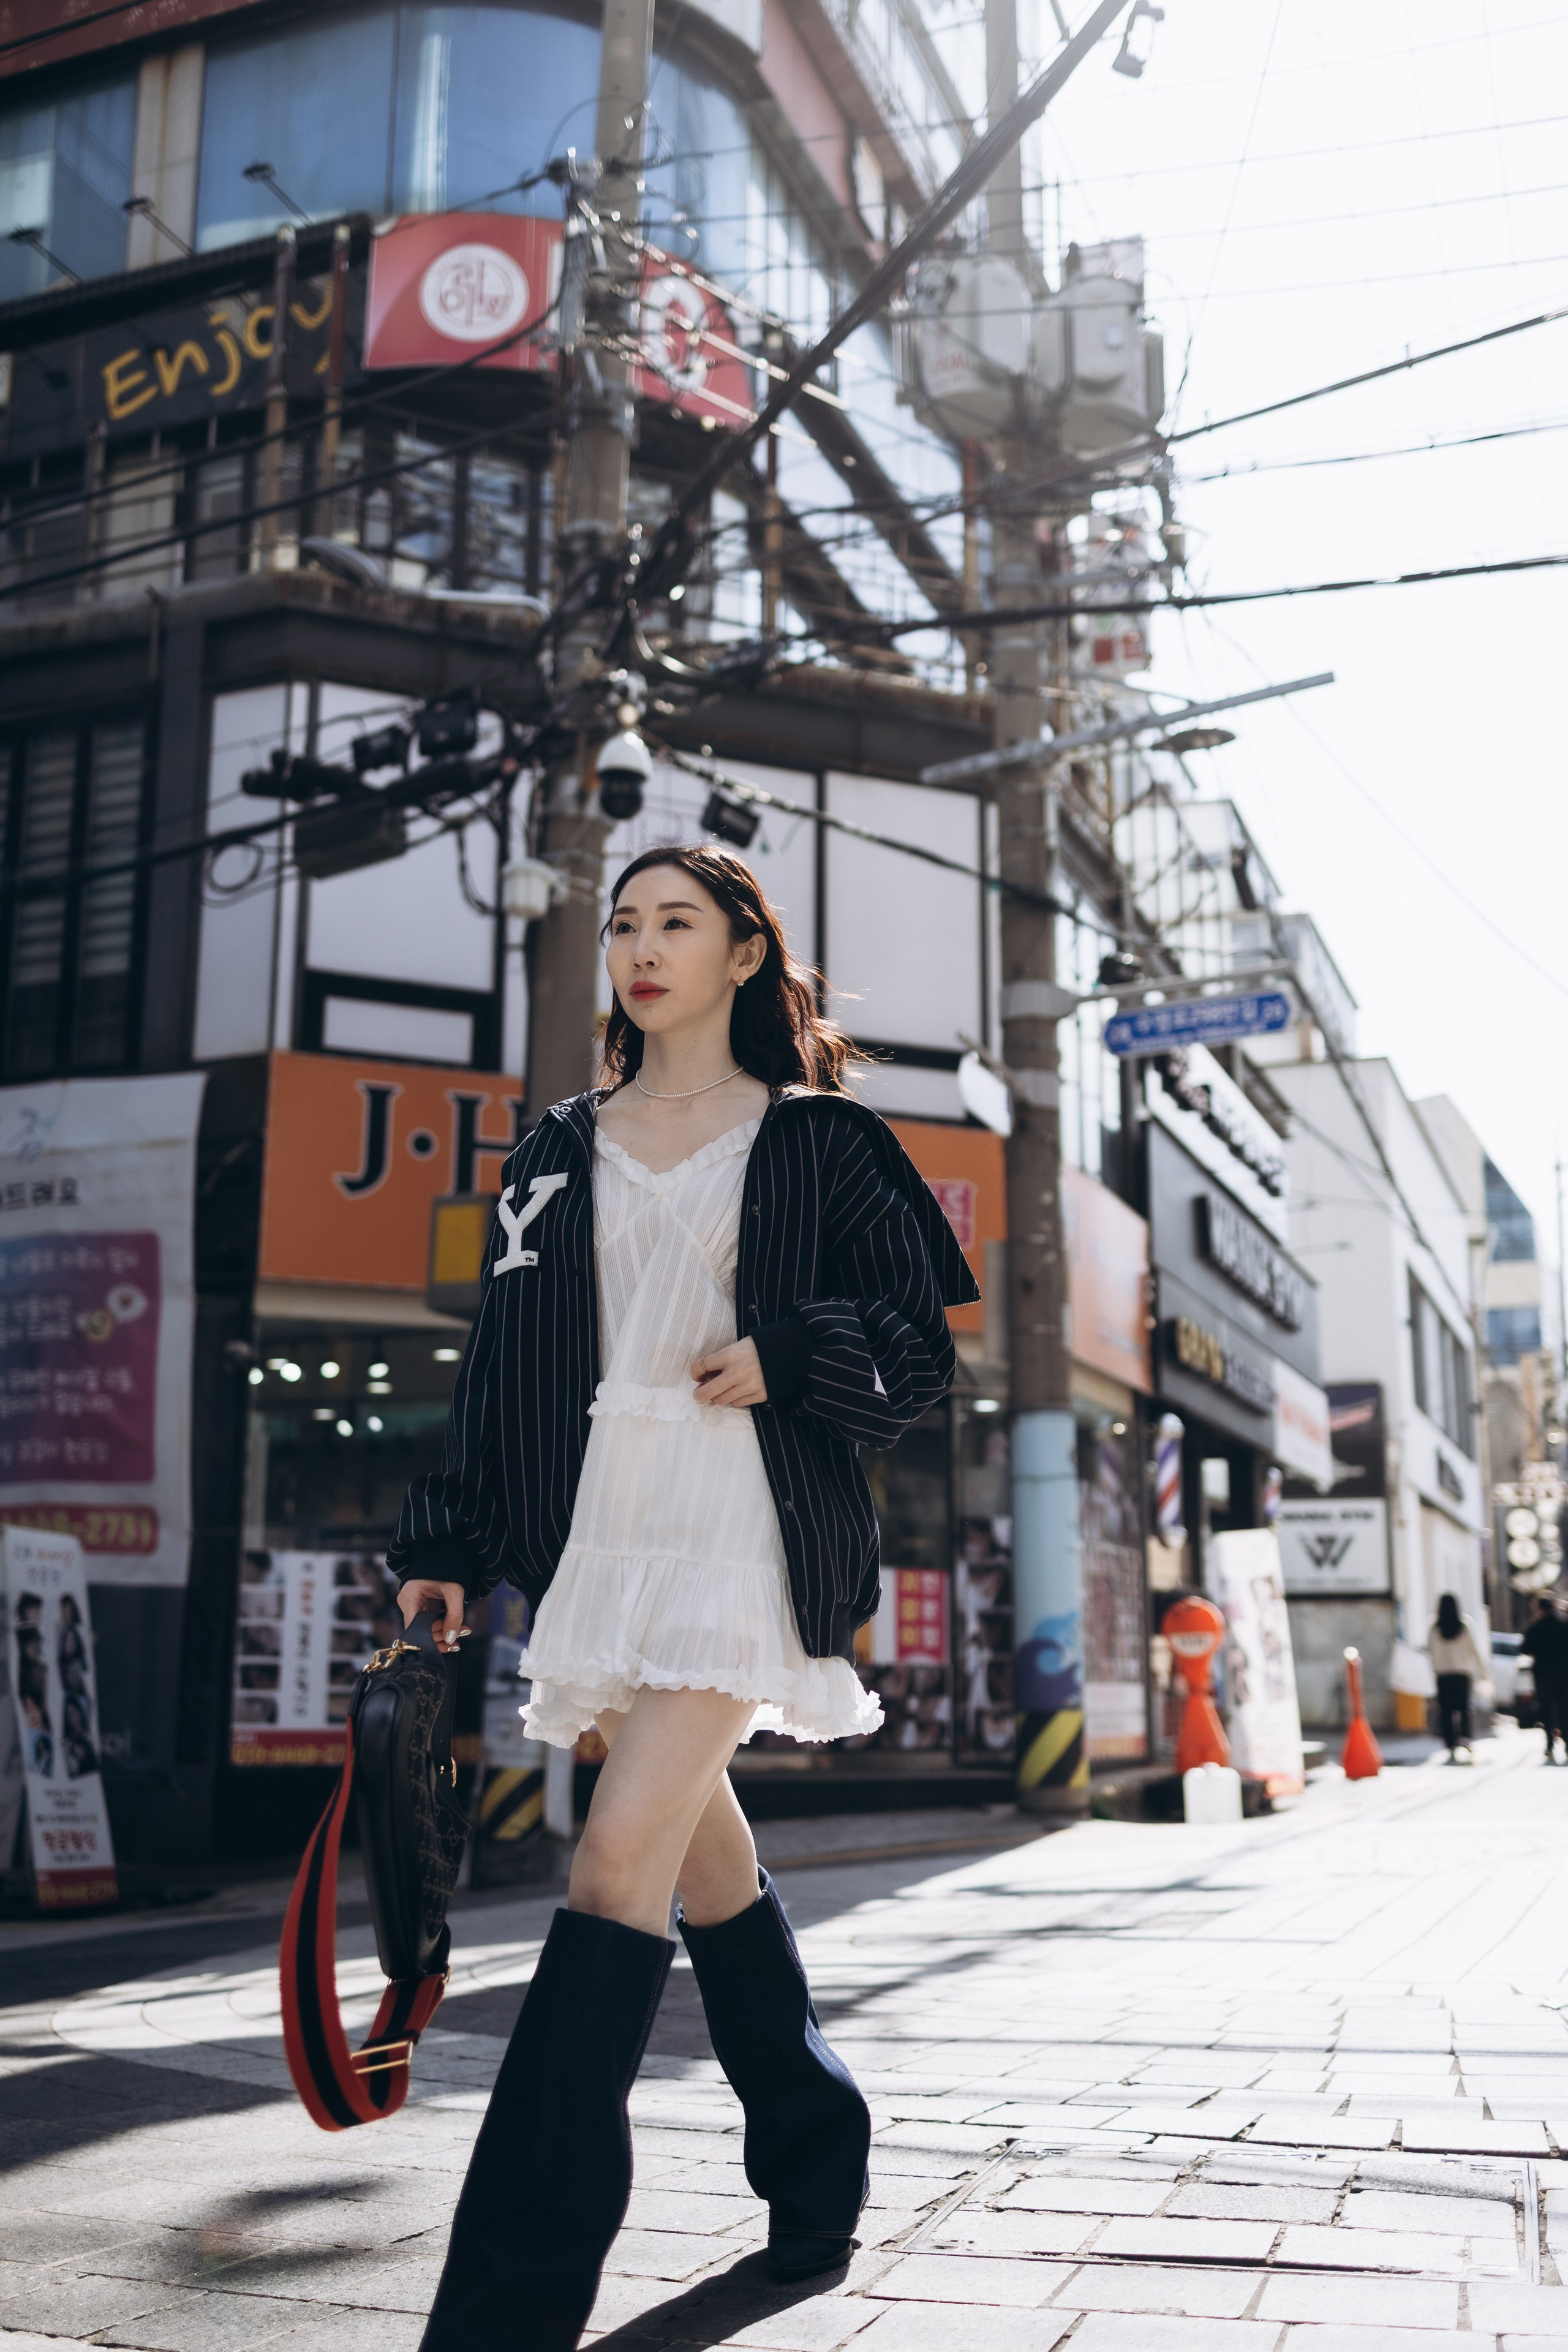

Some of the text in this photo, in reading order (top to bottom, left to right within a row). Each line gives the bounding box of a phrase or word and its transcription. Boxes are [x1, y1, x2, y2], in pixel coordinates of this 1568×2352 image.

[103, 284, 334, 420] Enjoy
[0, 1176, 80, 1212] 드려요
[493, 1172, 568, 1278] Y
